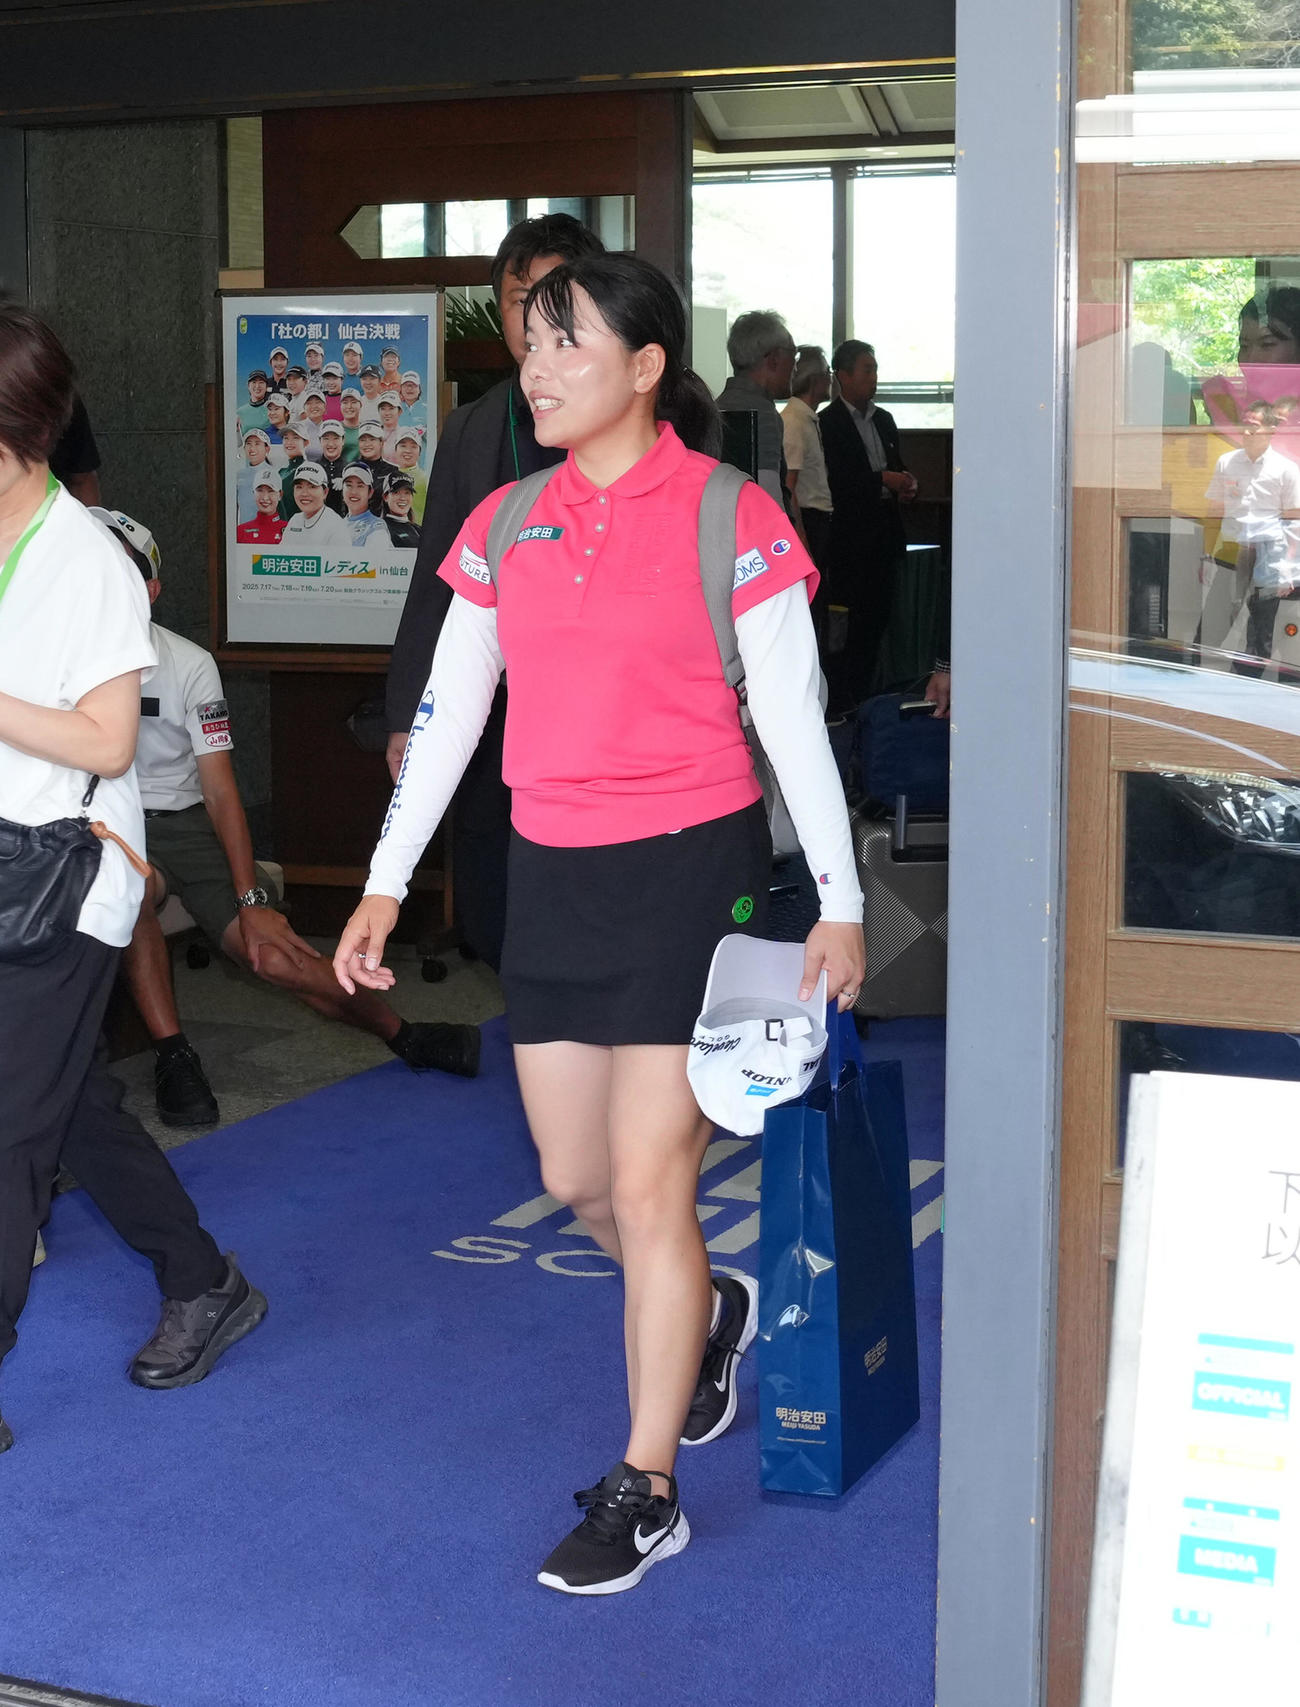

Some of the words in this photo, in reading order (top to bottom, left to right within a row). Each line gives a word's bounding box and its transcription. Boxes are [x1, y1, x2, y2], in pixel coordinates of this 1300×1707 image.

[271, 323, 330, 339] 「杜の都」
[338, 323, 400, 340] 仙台決戦
[262, 558, 317, 574] 明治安田
[324, 561, 370, 574] レディス
[242, 583, 259, 591] 2025
[775, 1407, 827, 1425] 明治安田
[798, 1423, 821, 1431] YASUDA
[1193, 1547, 1260, 1574] MEDIA
